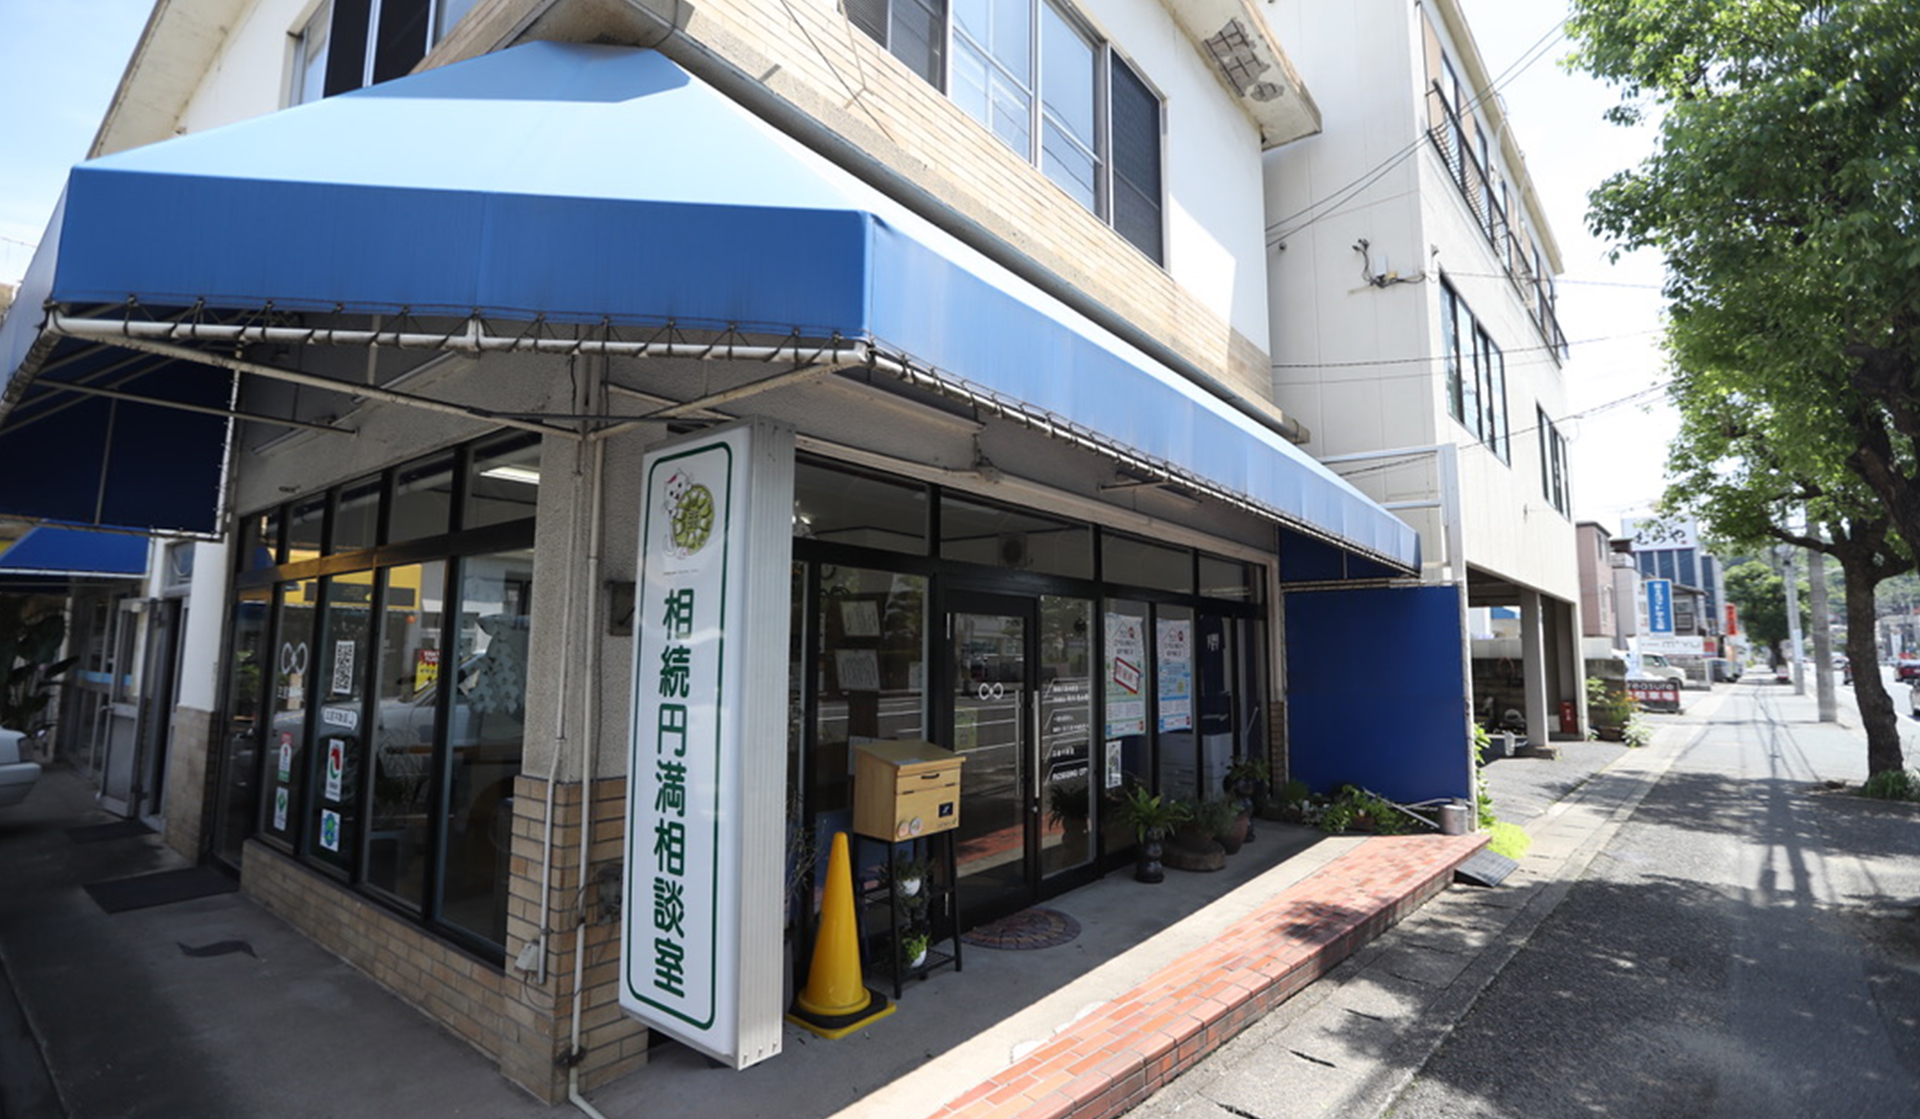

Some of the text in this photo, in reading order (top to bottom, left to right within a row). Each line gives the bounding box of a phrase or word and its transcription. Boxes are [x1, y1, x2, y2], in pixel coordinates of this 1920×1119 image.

[652, 587, 695, 998] 相続円満相談室
